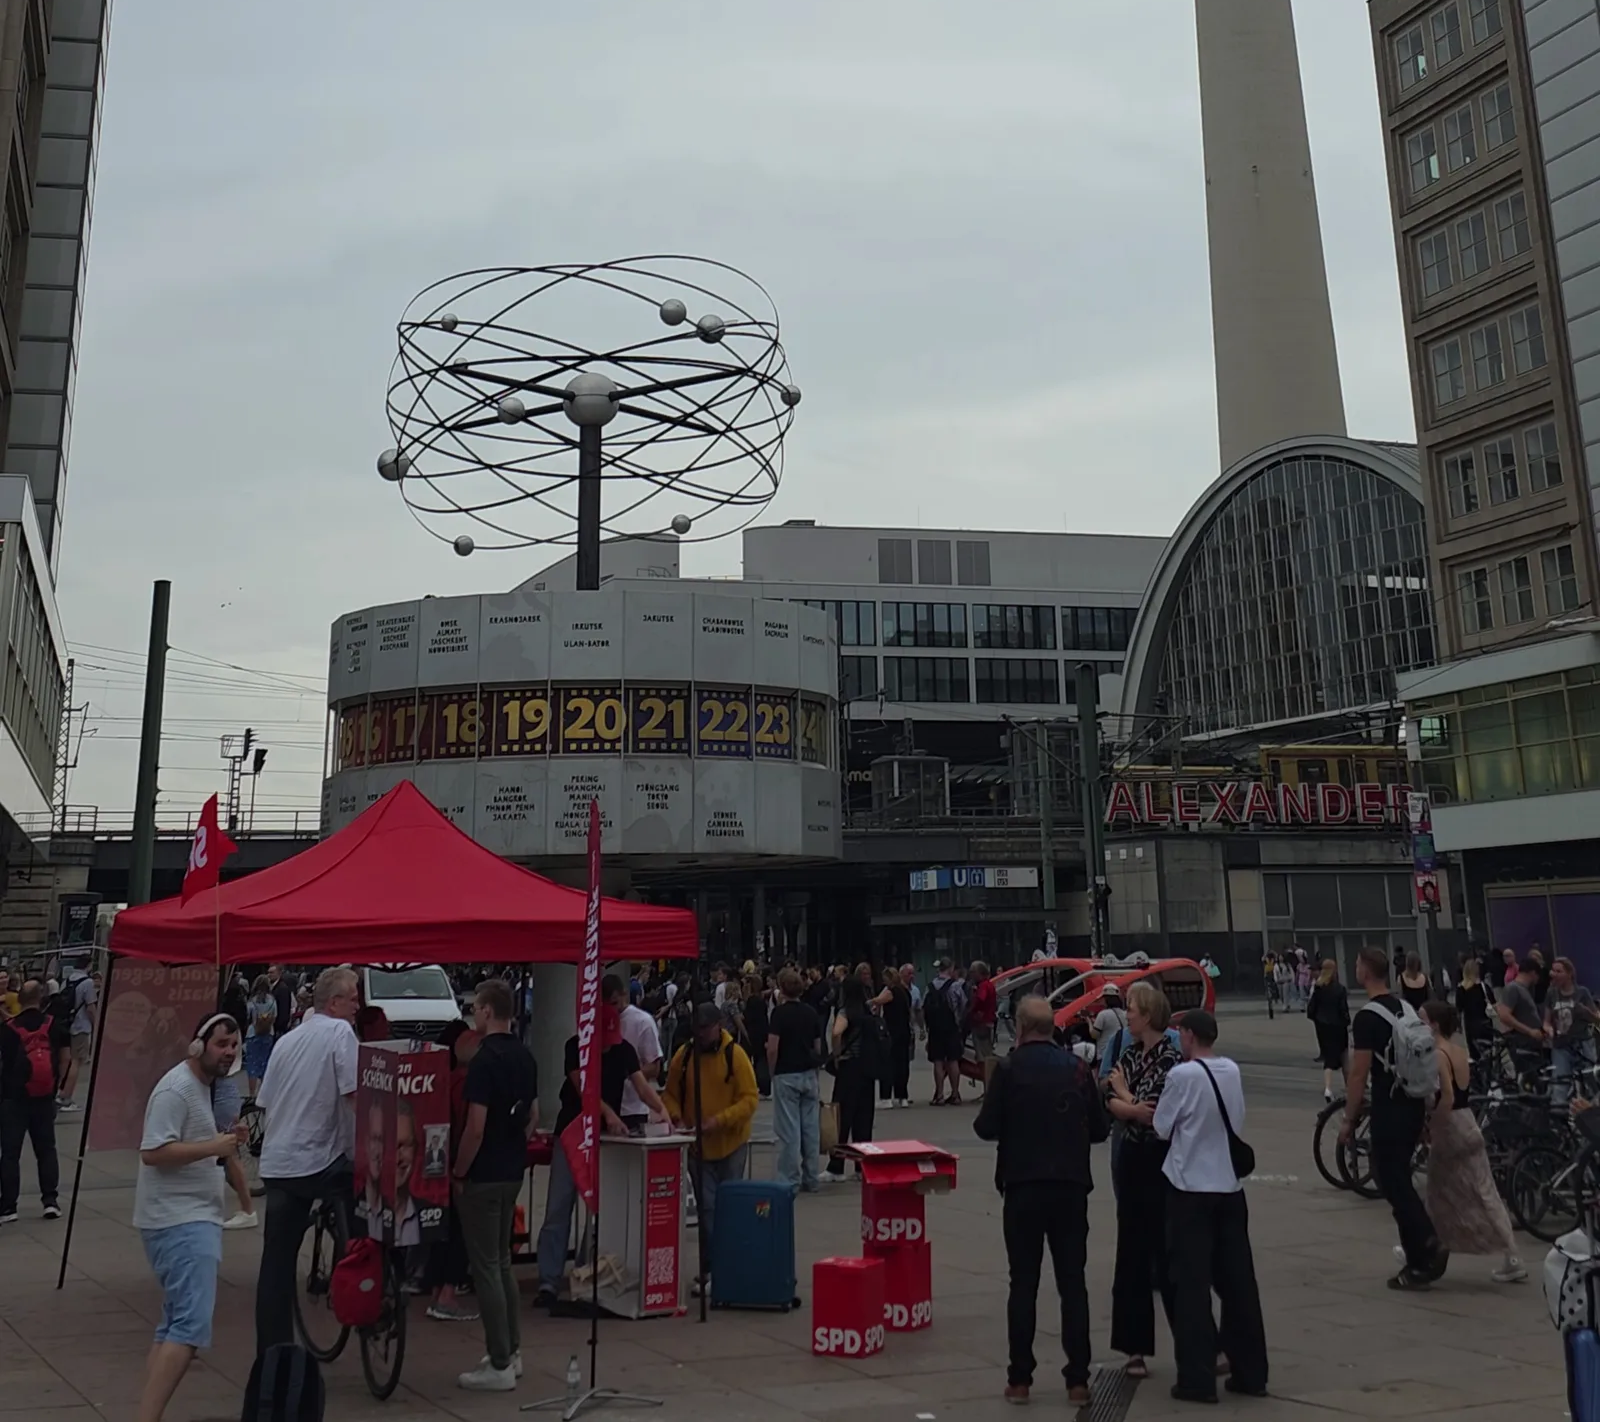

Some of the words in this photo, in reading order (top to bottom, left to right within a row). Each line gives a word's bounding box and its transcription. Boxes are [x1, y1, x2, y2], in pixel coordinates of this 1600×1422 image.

[440, 619, 457, 627] OMSK
[489, 614, 541, 624] KRASNOJARSK
[642, 614, 674, 623] JAKUTSK
[572, 622, 603, 630] IRKUTSK
[430, 635, 467, 646] TASCHKENT
[563, 639, 610, 648] ULAN-BATOR
[443, 700, 485, 744] 18
[502, 698, 552, 741] 19
[564, 697, 627, 740] 20
[637, 698, 685, 739] 21
[699, 699, 748, 741] 22
[394, 704, 429, 747] 17
[756, 703, 790, 745] 23
[571, 775, 599, 783] PEKING
[498, 786, 523, 794] HANOI
[563, 784, 606, 792] SHANGHAI
[493, 794, 527, 803] BANGKOK
[569, 793, 600, 801] MANILA
[647, 792, 669, 801] TOKYO
[485, 804, 512, 813] PHNOM
[515, 803, 535, 811] PENH
[572, 802, 591, 810] PERT
[646, 801, 669, 810] SEOUL
[492, 813, 527, 821] JAKARTA
[713, 811, 737, 820] SYDNEY
[555, 820, 580, 829] KUALA
[707, 820, 743, 828] CANBERRA
[706, 829, 744, 838] MELBOURNE
[954, 869, 967, 887] U
[419, 1207, 443, 1221] SPD
[876, 1217, 922, 1242] SPD
[646, 1292, 663, 1306] SPD
[883, 1301, 909, 1327] PD
[911, 1300, 931, 1328] SPD
[814, 1326, 861, 1354] SPD
[864, 1324, 884, 1354] SPD
